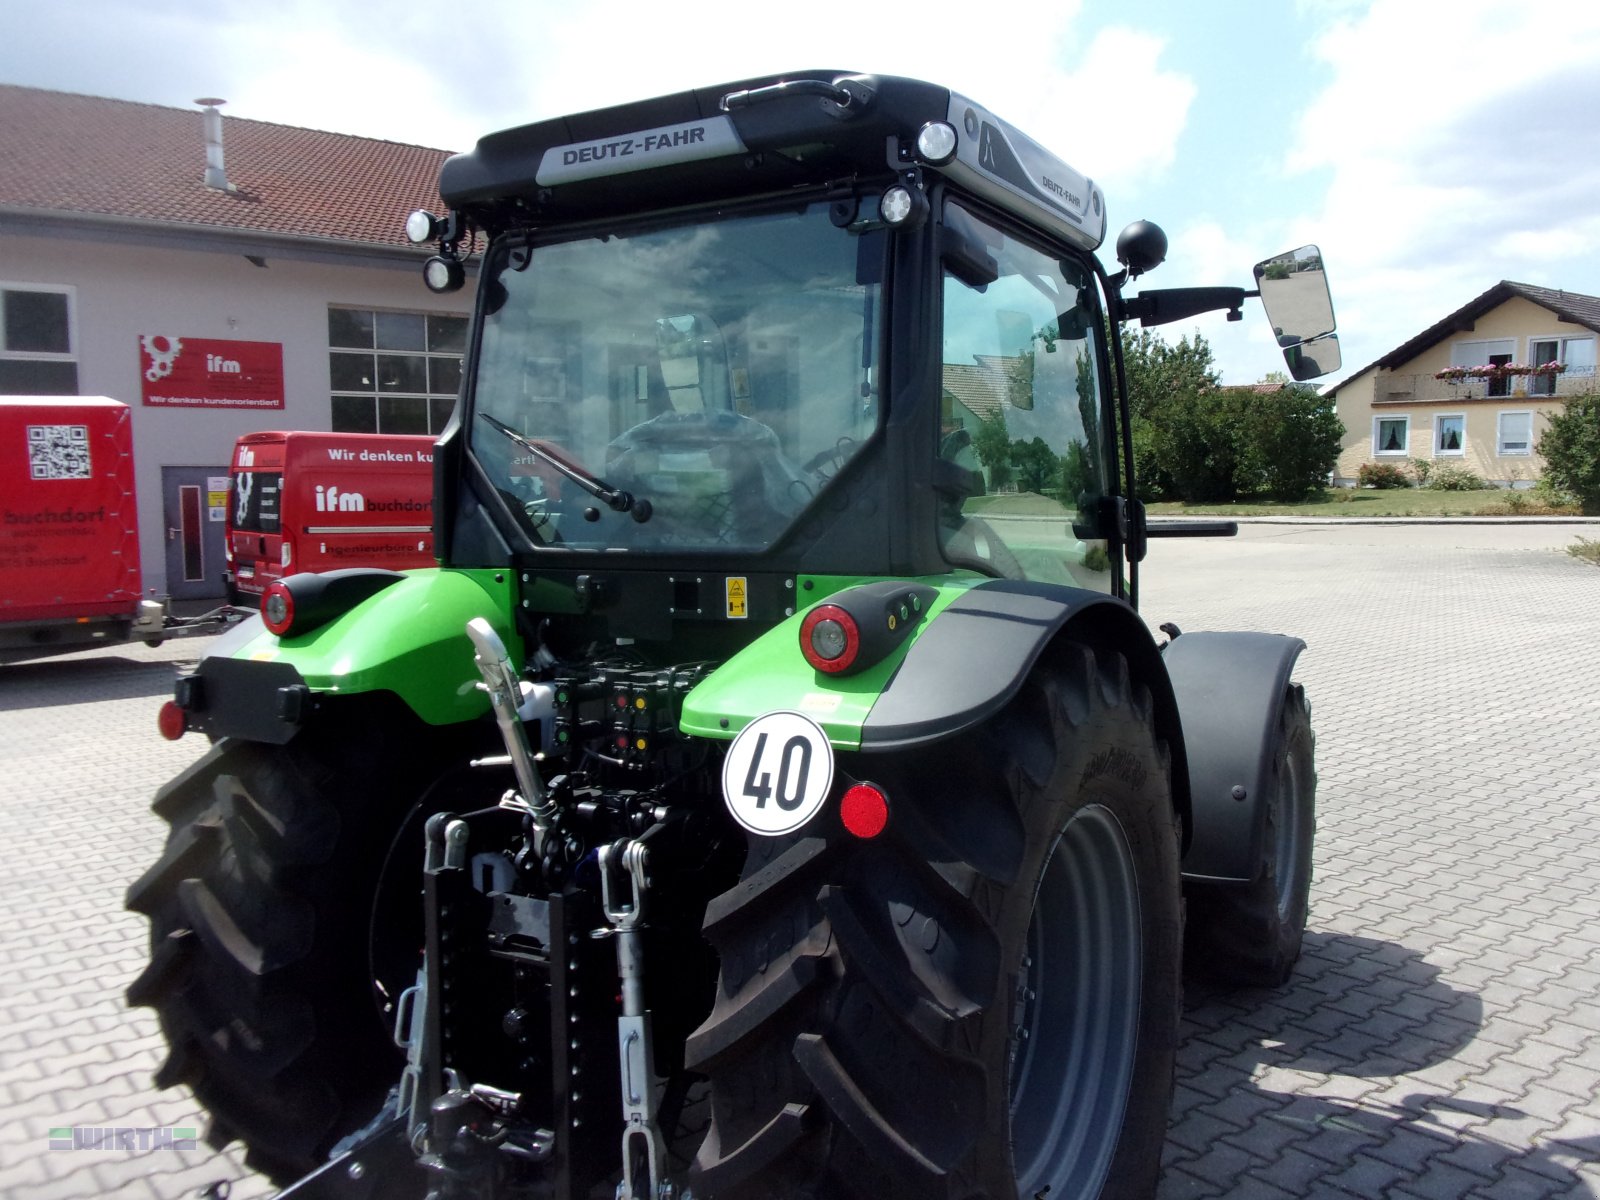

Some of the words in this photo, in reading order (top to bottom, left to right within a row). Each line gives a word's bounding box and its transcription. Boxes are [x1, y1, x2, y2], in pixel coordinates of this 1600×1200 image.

[563, 127, 705, 166] DEUTZ-FAHR
[1042, 176, 1081, 208] DEUTZ-FAHR
[207, 353, 241, 373] ifm
[149, 395, 166, 404] Wir
[167, 396, 203, 405] denken
[203, 397, 280, 407] kundenorientiert!
[327, 448, 355, 461] Wir
[359, 449, 413, 463] denken
[315, 485, 365, 512] ifm
[4, 506, 105, 524] buchdorf
[742, 732, 813, 812] 40
